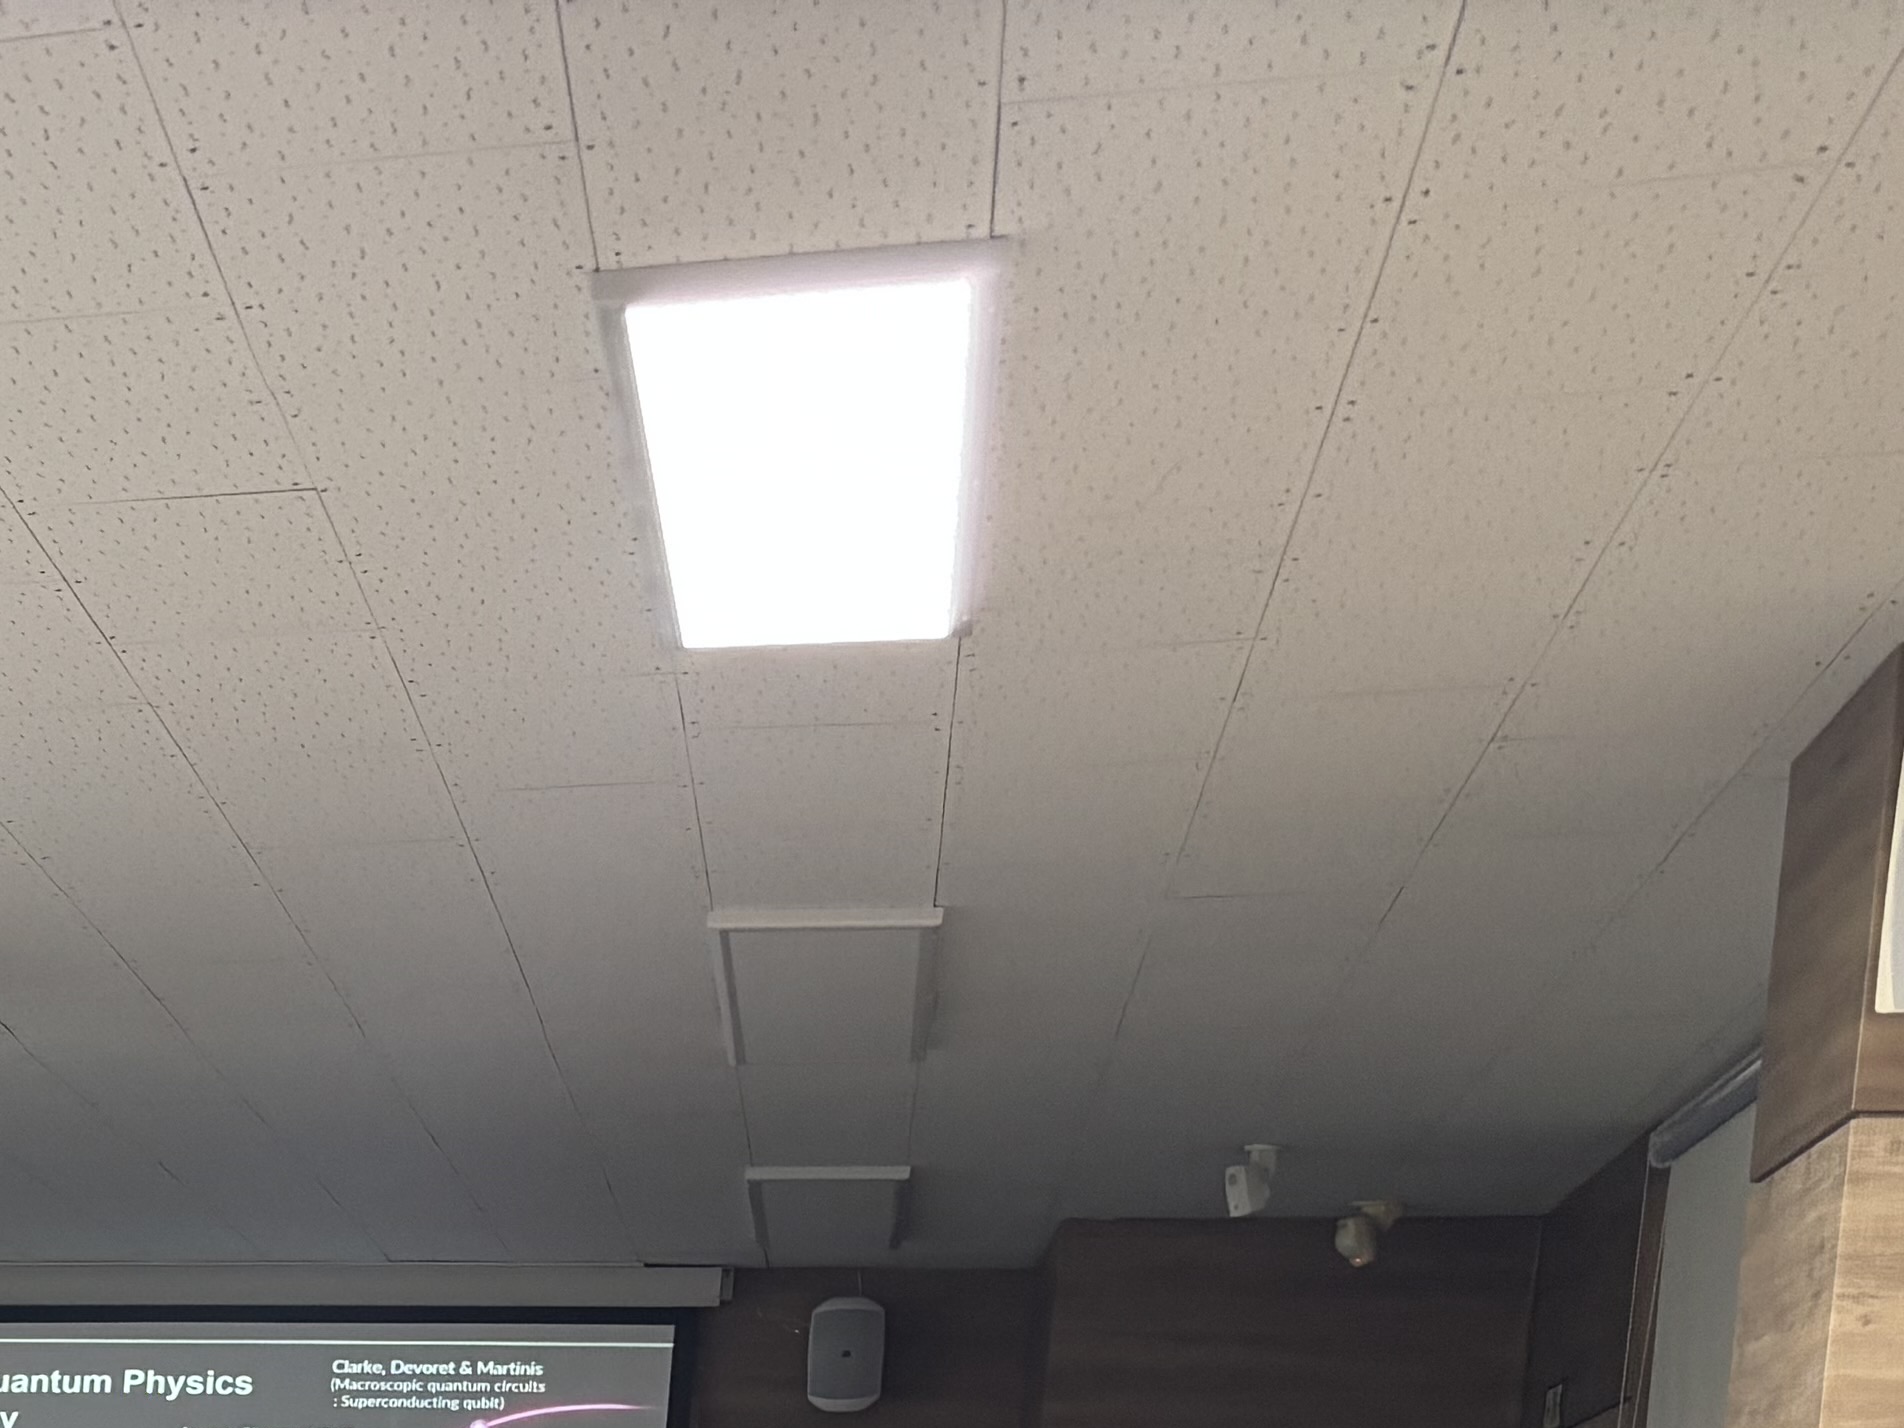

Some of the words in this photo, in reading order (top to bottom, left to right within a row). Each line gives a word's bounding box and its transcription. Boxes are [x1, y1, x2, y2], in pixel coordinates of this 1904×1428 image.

[332, 1359, 386, 1376] Clarke,
[390, 1359, 455, 1375] Devoret
[459, 1361, 473, 1375] &
[477, 1361, 544, 1376] Martinis
[123, 1369, 253, 1401] Physics
[330, 1377, 424, 1393] (Macroscopic
[427, 1380, 491, 1393] quantum
[494, 1380, 546, 1393] circuits
[341, 1395, 459, 1410] Superconducting
[463, 1397, 505, 1411] qubit)
